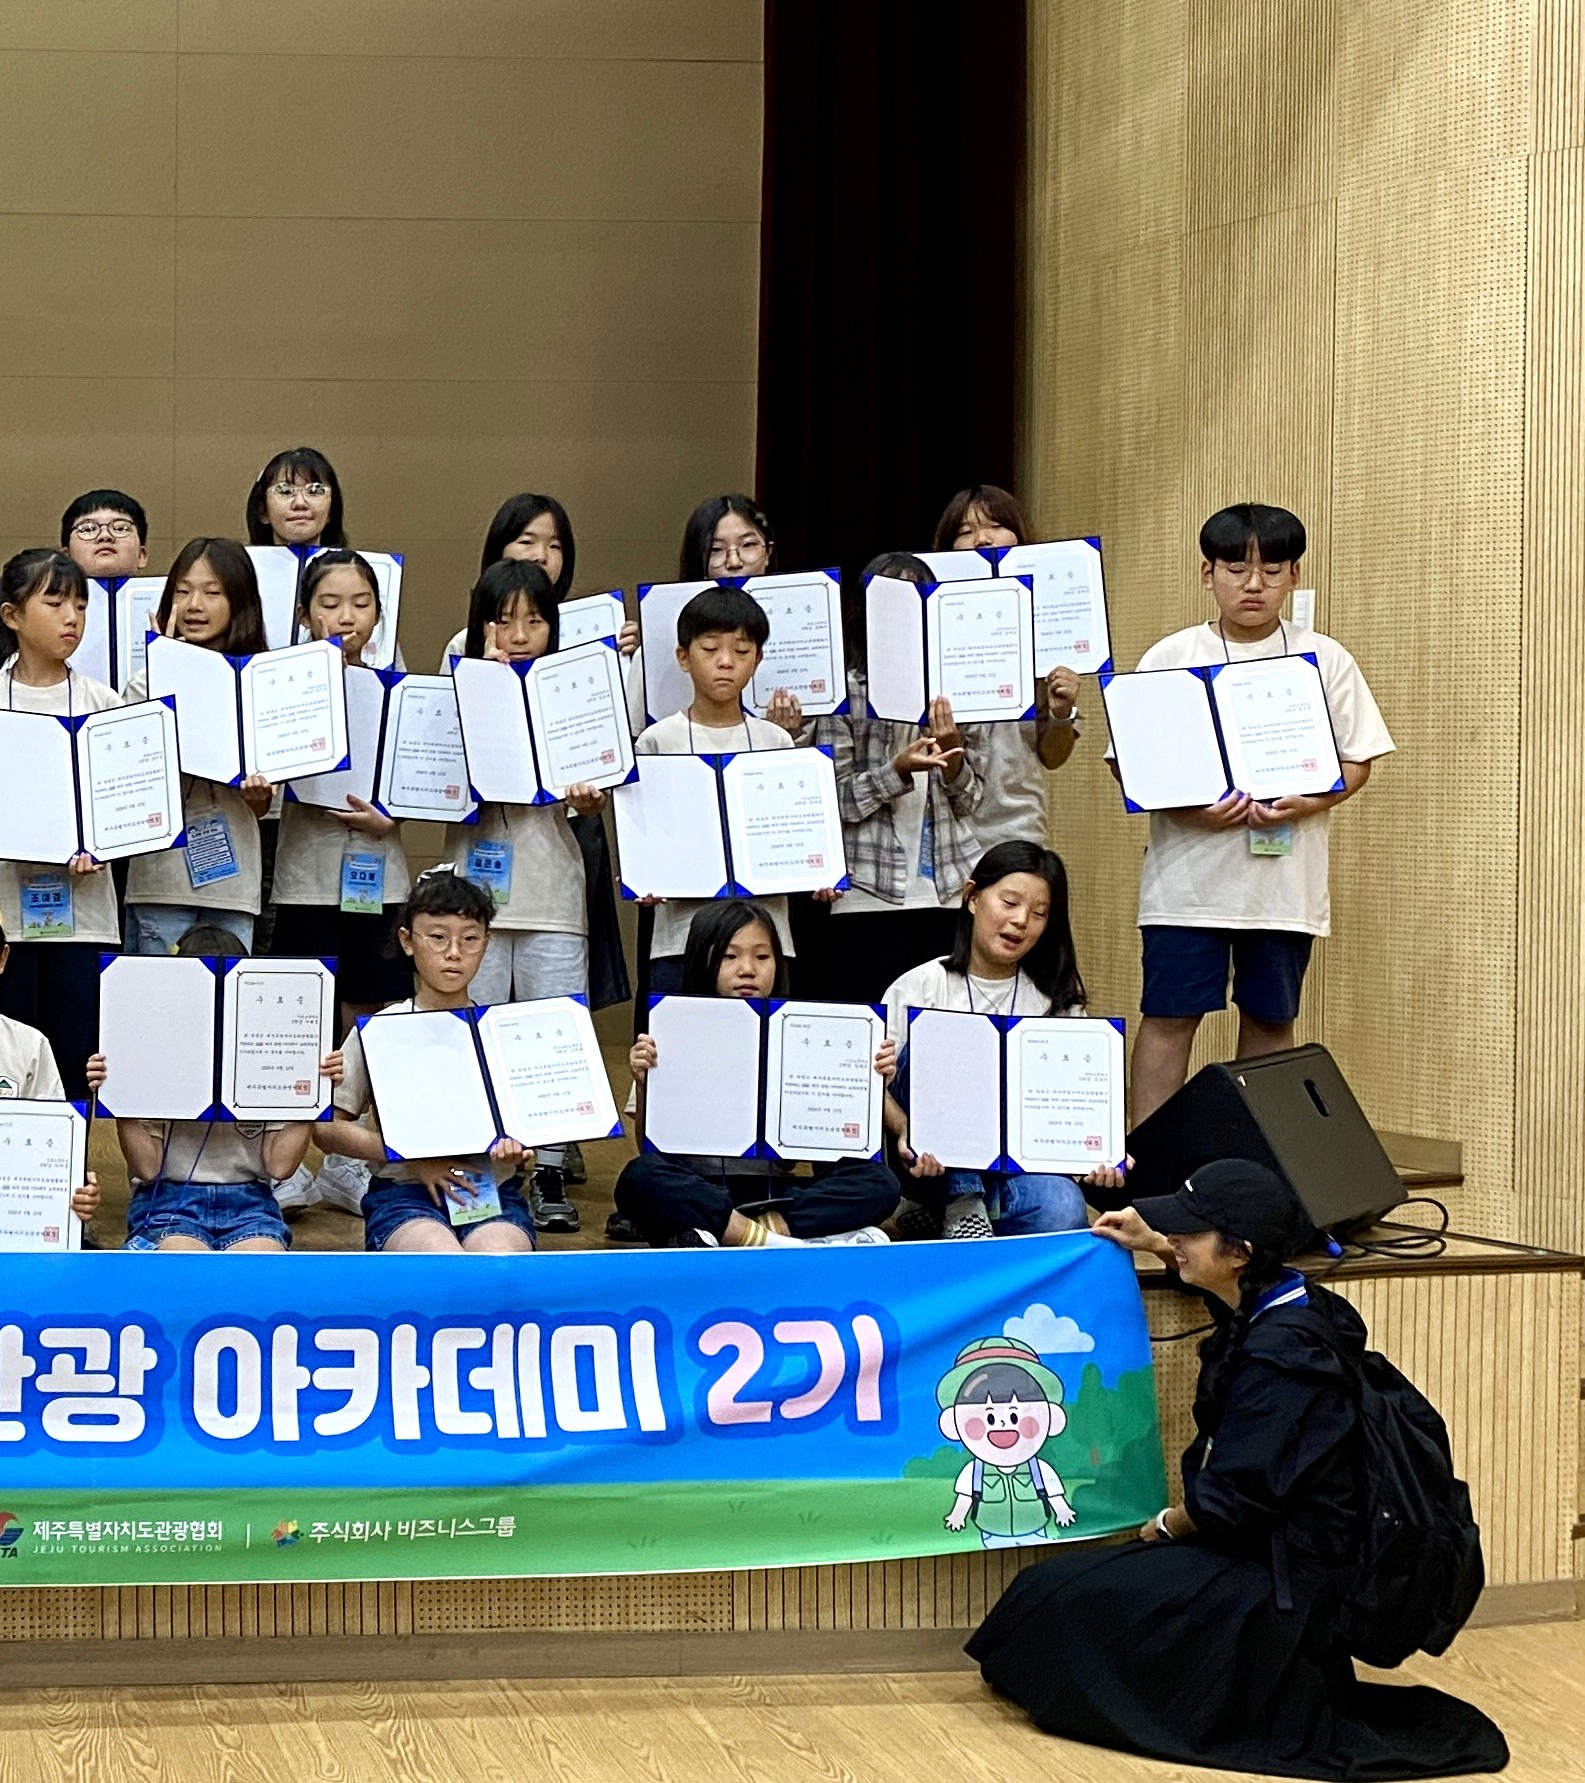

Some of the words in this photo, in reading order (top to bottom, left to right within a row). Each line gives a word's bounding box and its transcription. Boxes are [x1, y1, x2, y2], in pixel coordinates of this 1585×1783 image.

[193, 1320, 666, 1441] 아카데미
[698, 1314, 884, 1425] 2기
[32, 1520, 224, 1542] 제주특별자치도관광협회
[308, 1520, 392, 1544] 주식회사
[397, 1516, 517, 1541] 비즈니스그룹
[32, 1544, 65, 1555] JEJU
[71, 1543, 130, 1554] TOURISM
[134, 1543, 223, 1554] ASSOCIATION
